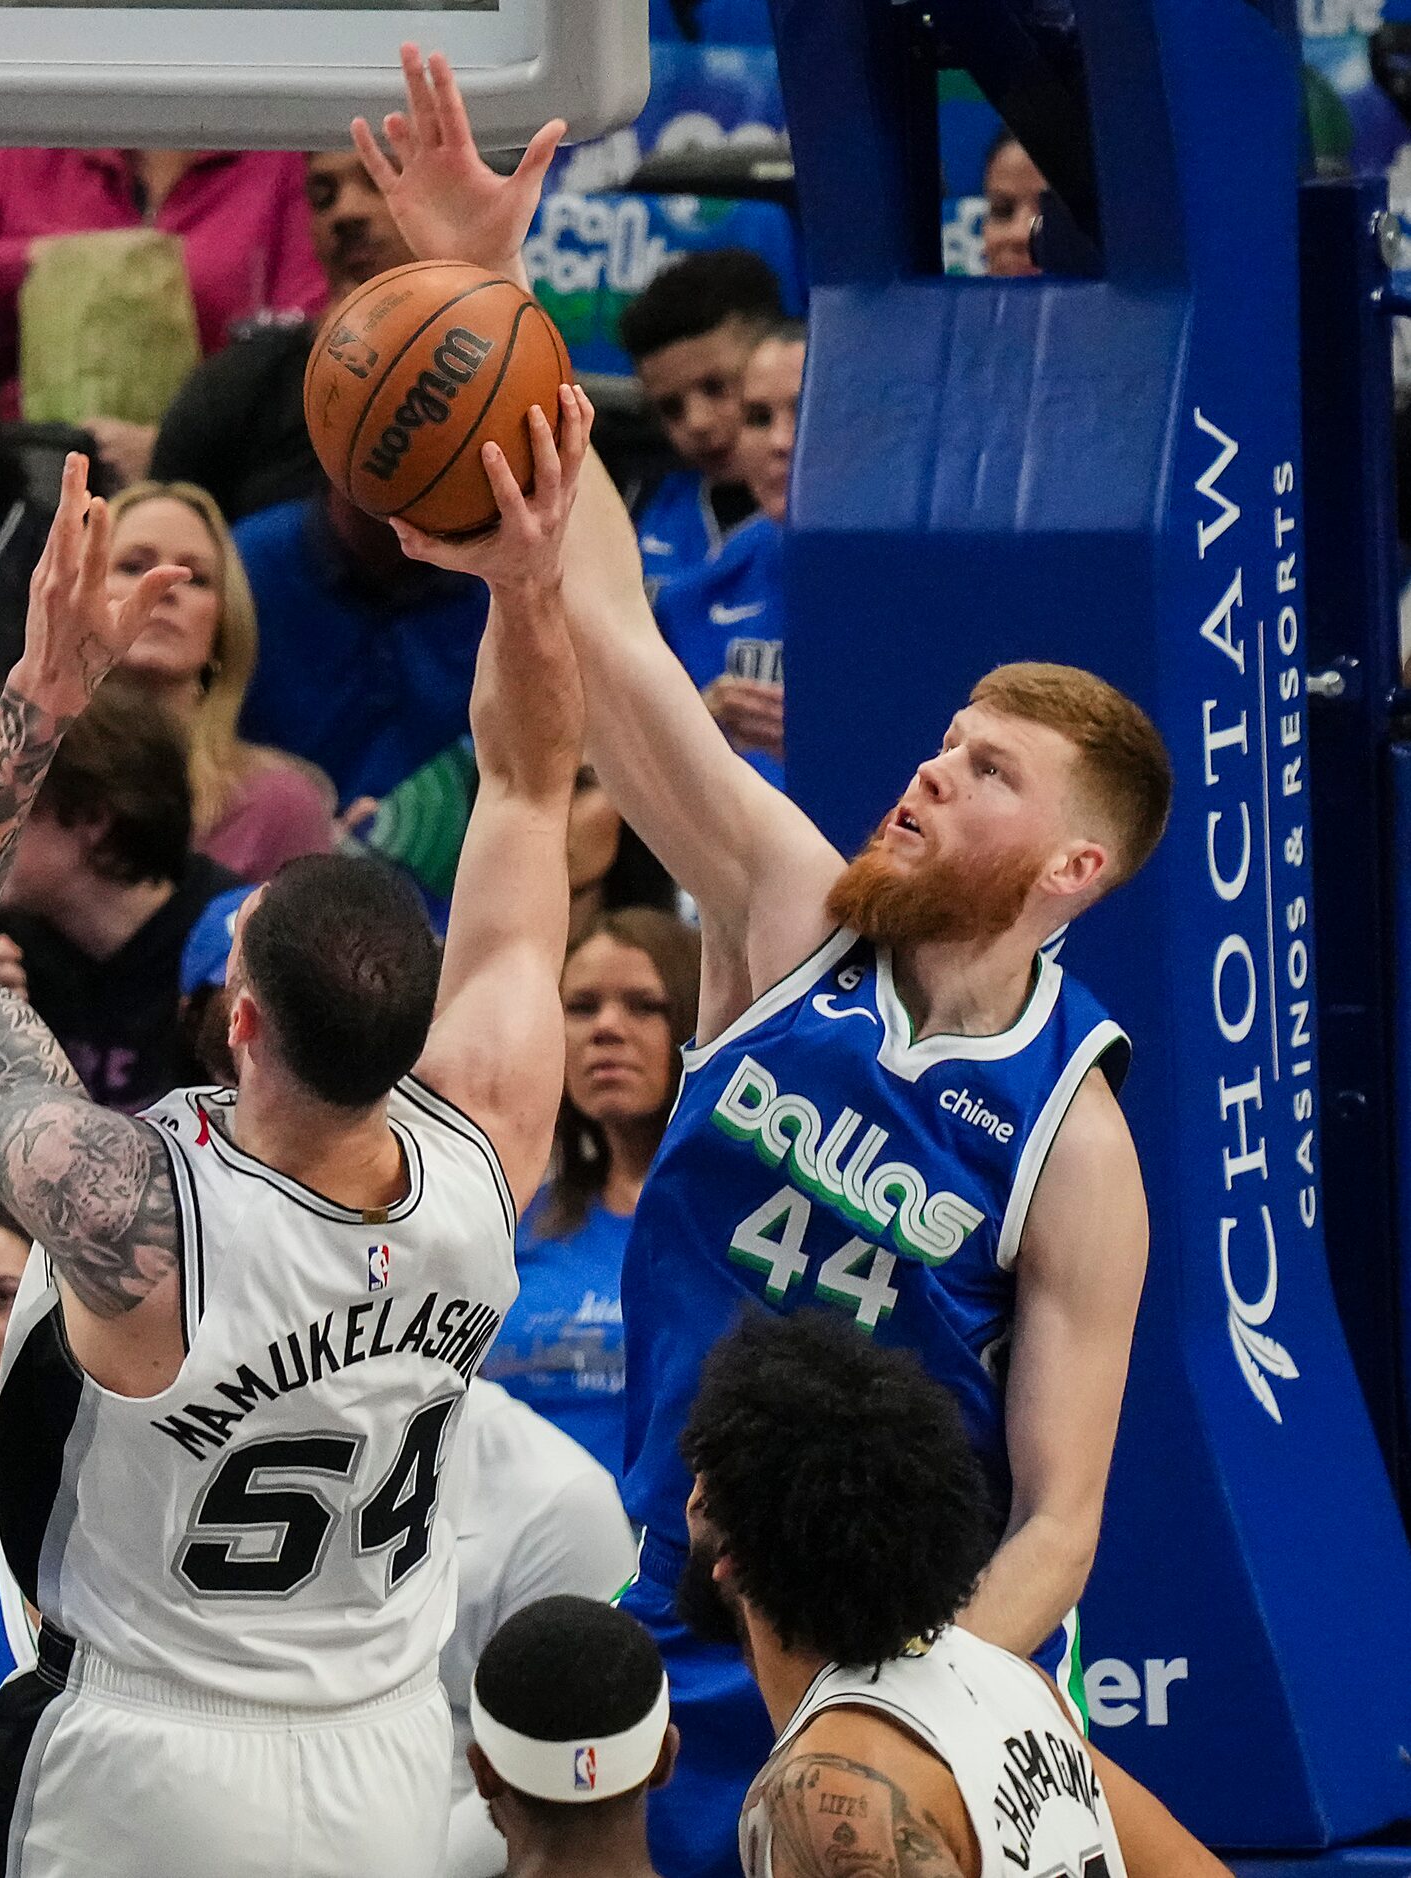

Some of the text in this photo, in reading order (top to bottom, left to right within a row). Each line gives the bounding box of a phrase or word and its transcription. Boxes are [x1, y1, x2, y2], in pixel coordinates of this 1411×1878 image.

[360, 326, 495, 481] Wilson
[1193, 406, 1279, 1327] CHOCTAW
[1273, 460, 1317, 1230] CASINOS & RESORTS
[711, 1054, 986, 1266] Dallas
[938, 1087, 1015, 1145] chime
[728, 1185, 900, 1333] 44
[170, 1389, 467, 1601] 54
